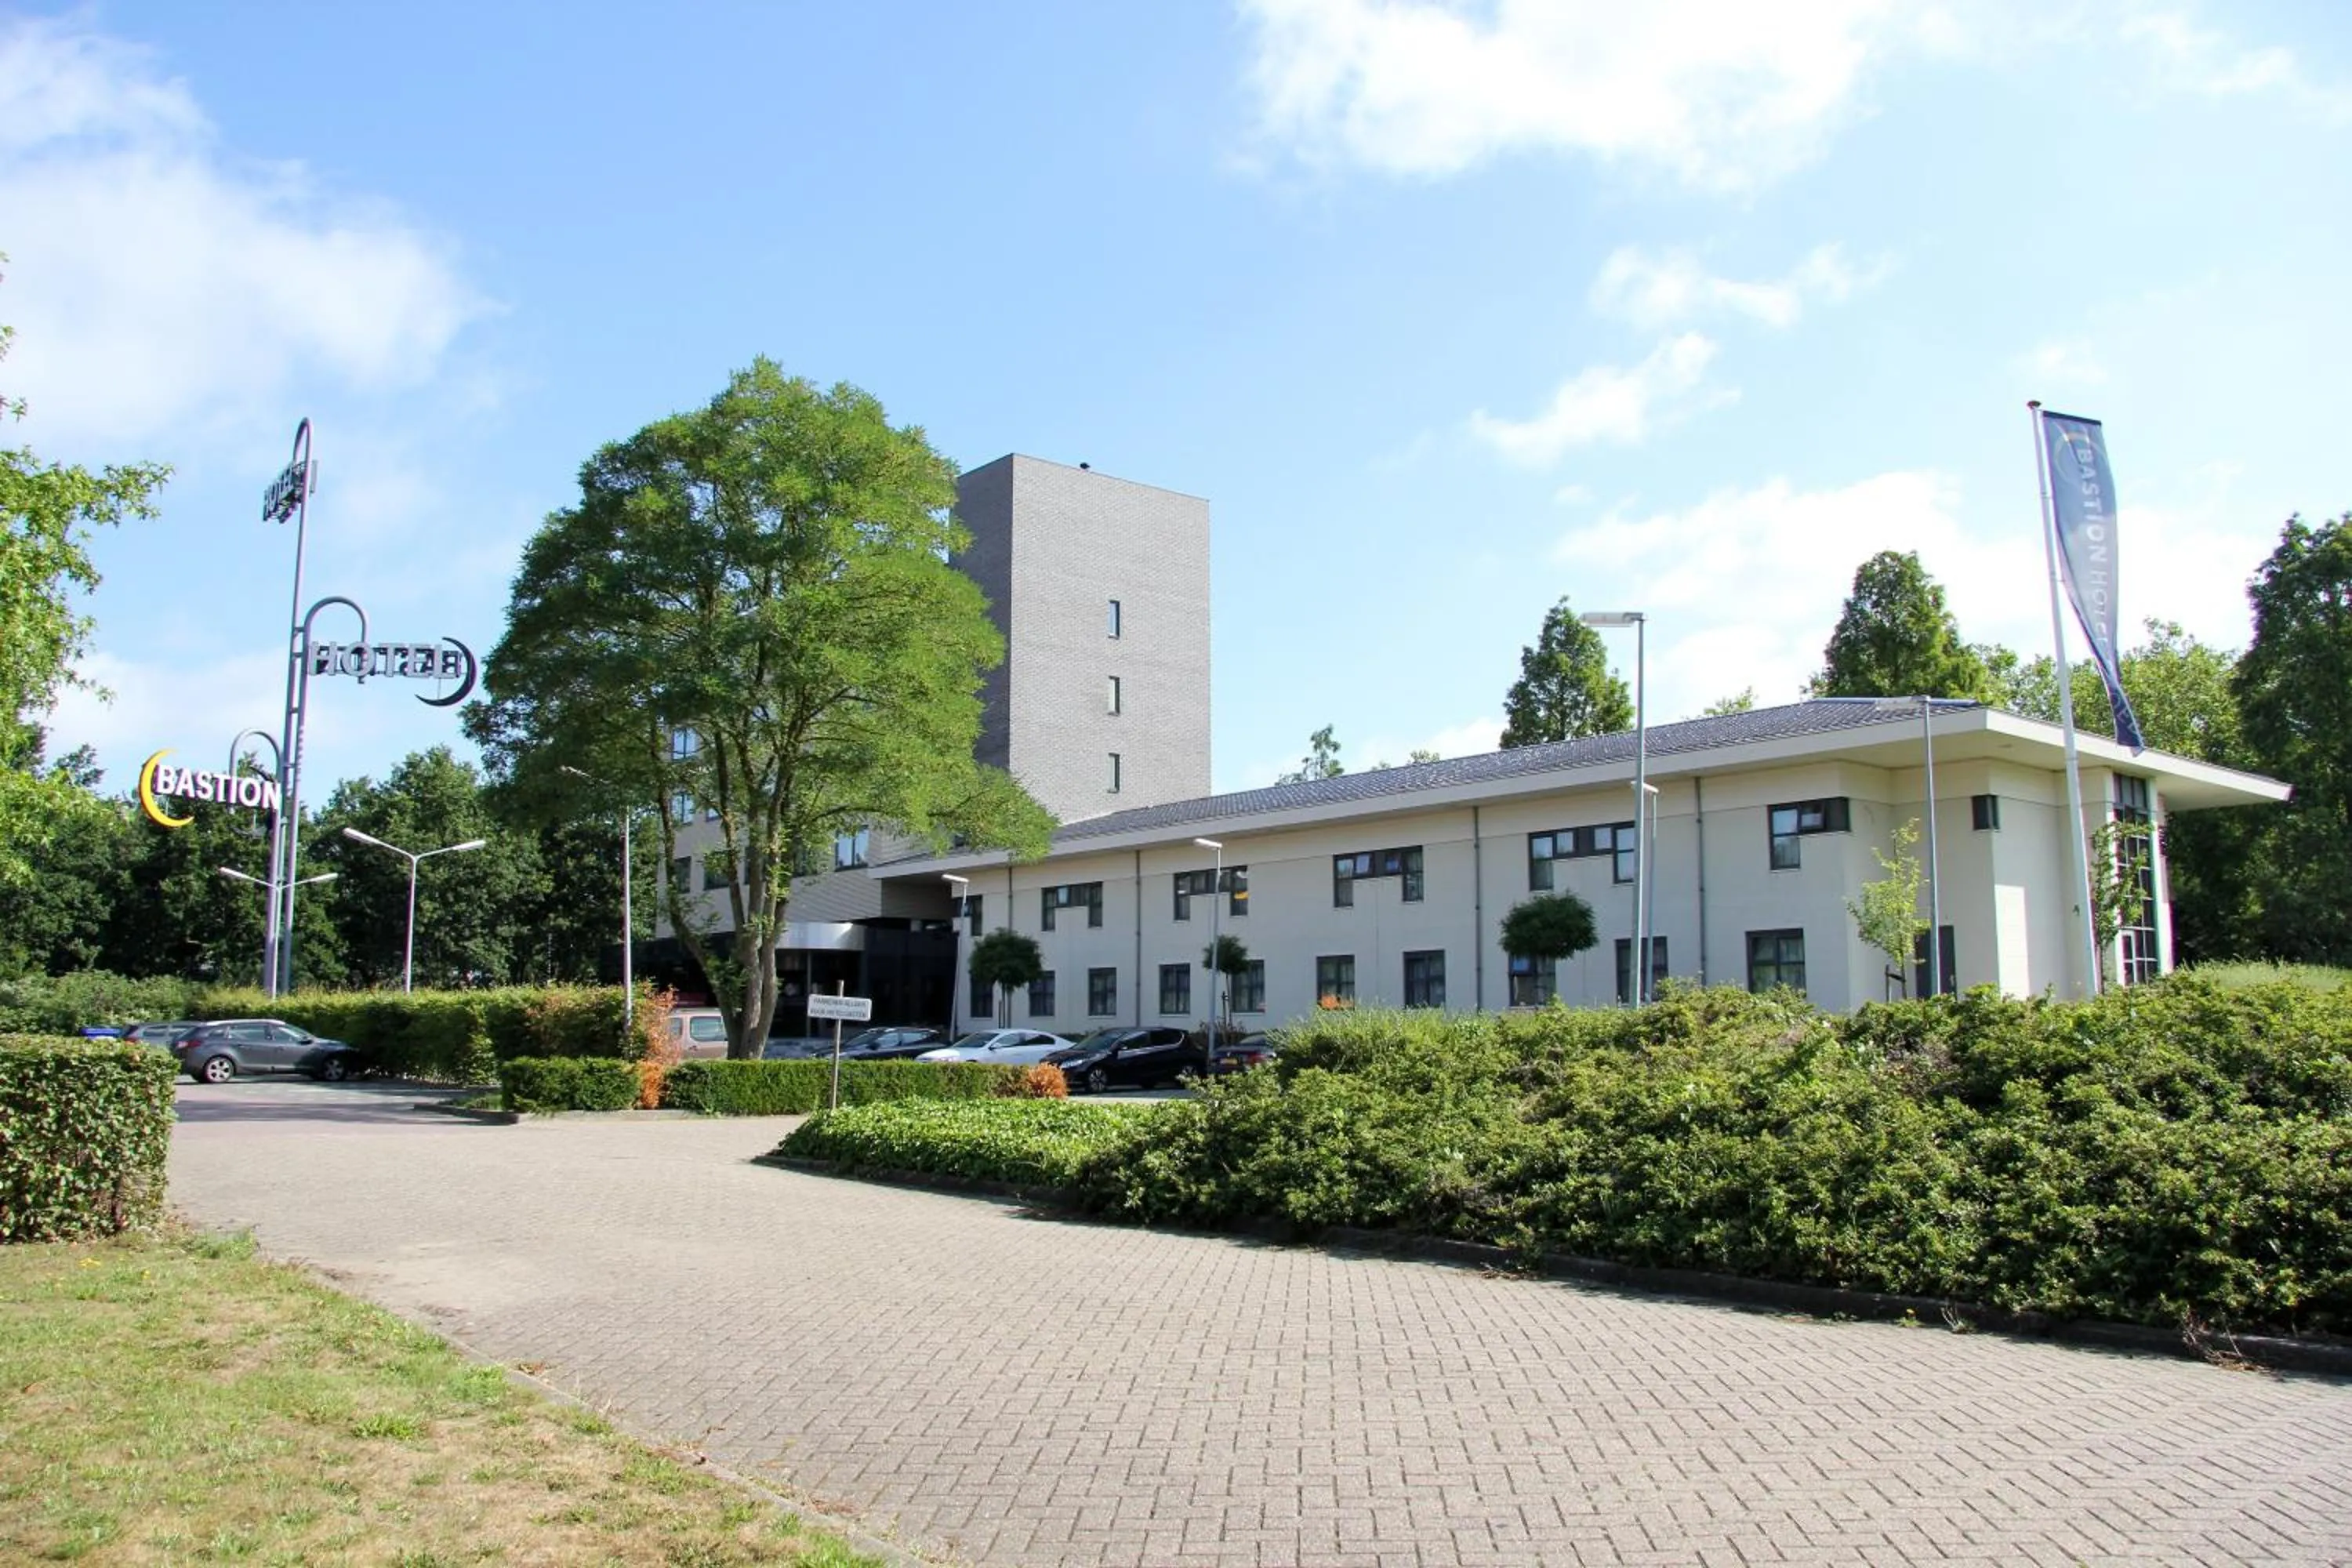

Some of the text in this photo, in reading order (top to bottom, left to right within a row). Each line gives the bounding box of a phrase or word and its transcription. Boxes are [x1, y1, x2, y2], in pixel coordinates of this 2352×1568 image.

[2076, 448, 2108, 563] BASTION
[308, 641, 460, 679] HOTEL
[154, 764, 281, 811] BASTION
